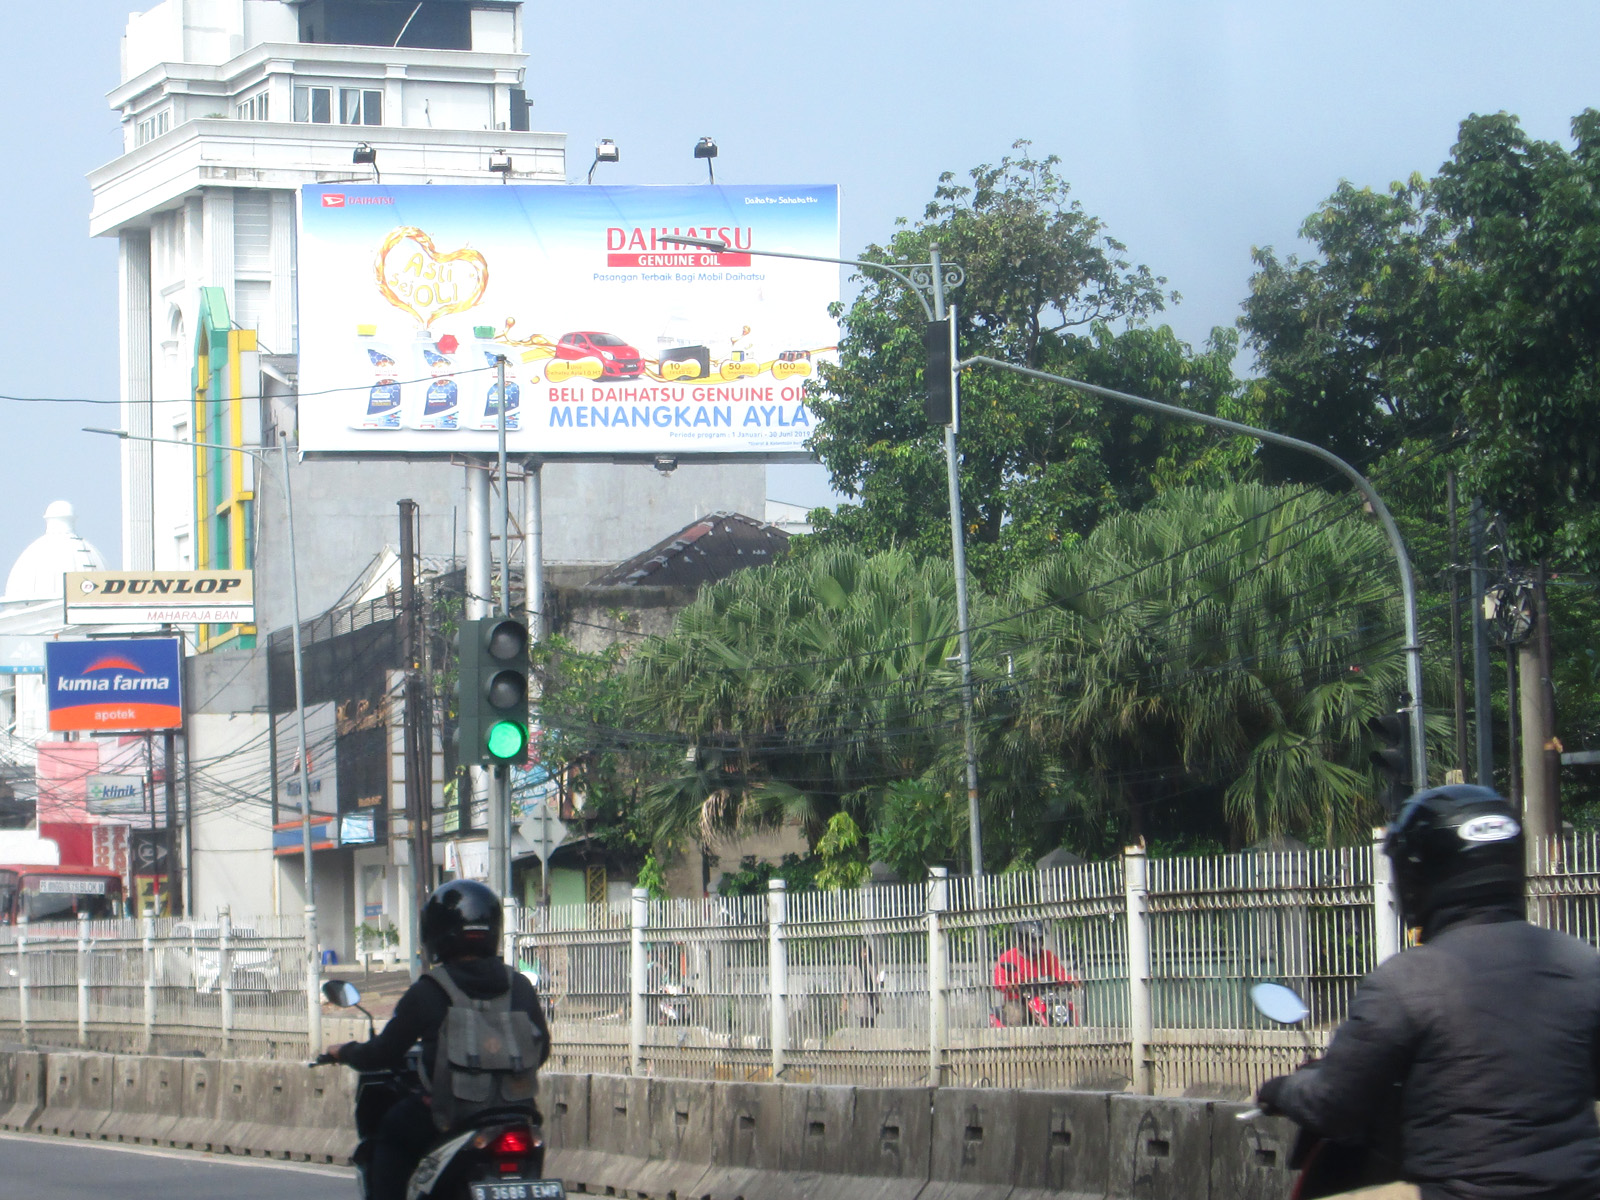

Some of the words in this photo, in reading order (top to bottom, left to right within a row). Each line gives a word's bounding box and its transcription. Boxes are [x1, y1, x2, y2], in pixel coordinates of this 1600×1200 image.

[348, 196, 395, 205] DAIHATSU
[745, 196, 777, 204] Daihatsu
[607, 227, 751, 250] DAIHATSU
[638, 255, 695, 266] GENUINE
[700, 255, 720, 266] OIL
[593, 273, 638, 283] Pasangan
[641, 272, 672, 281] Terbaik
[676, 273, 695, 283] Bagi
[698, 272, 722, 281] Mobil
[725, 272, 766, 281] Daihatsu
[669, 362, 681, 370] 10
[549, 387, 584, 402] BELI
[592, 387, 684, 402] DAIHATSU
[692, 387, 773, 402] GENUINE
[549, 405, 731, 427] MENANGKAN
[743, 405, 809, 427] AYLA
[100, 578, 241, 595] DUNLOP
[147, 611, 211, 621] MAHARAJA
[214, 610, 239, 620] BAN
[57, 676, 110, 692] kimia
[113, 675, 169, 691] farma
[94, 708, 135, 722] apotek
[102, 784, 136, 798] klinik
